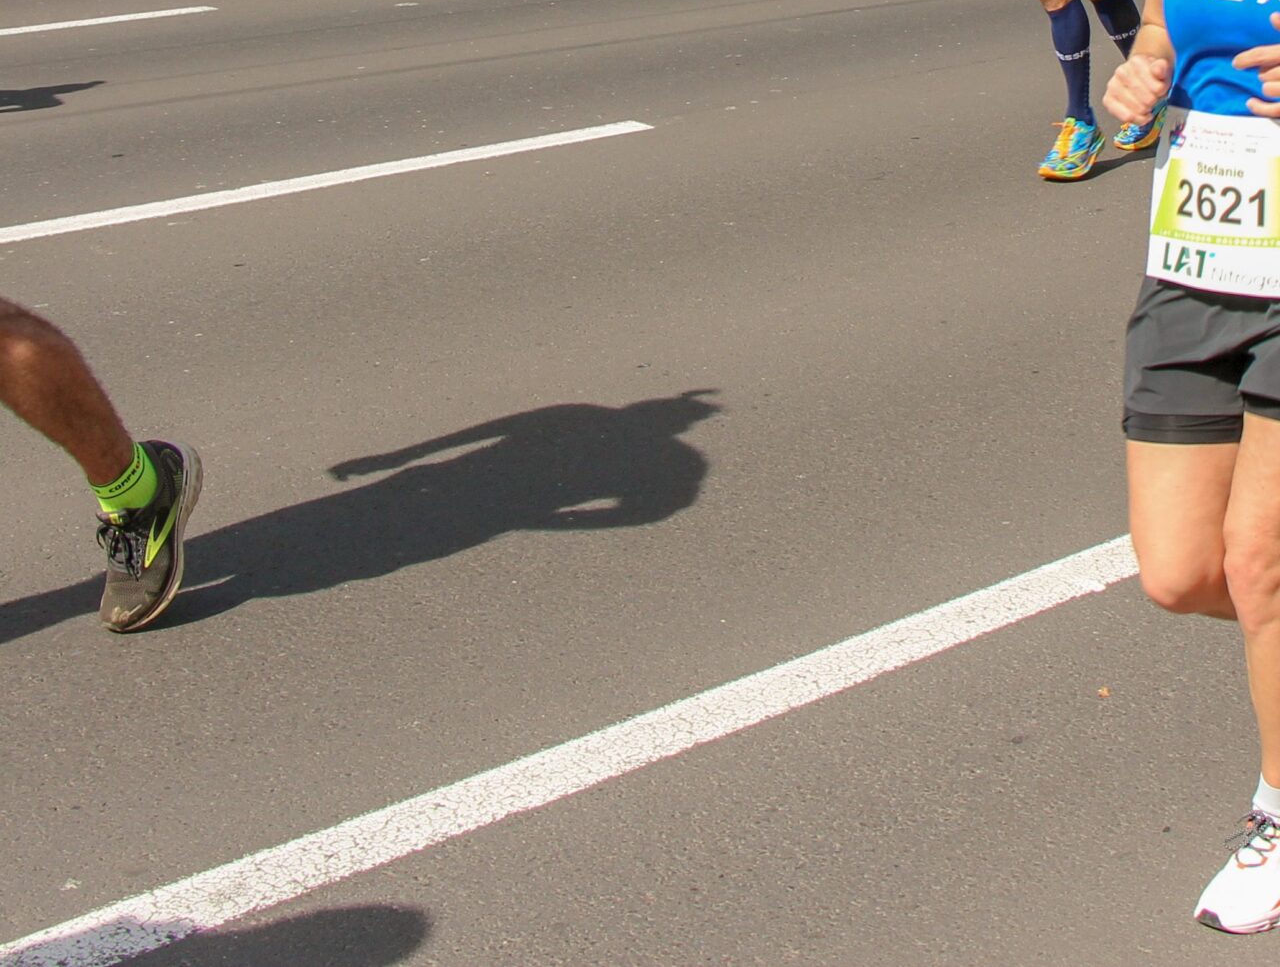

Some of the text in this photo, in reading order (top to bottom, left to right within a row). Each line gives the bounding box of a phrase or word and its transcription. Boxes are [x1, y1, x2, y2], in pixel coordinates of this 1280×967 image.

[1196, 161, 1245, 179] Stefanie
[1176, 178, 1267, 228] 2621
[1162, 242, 1207, 280] LAT
